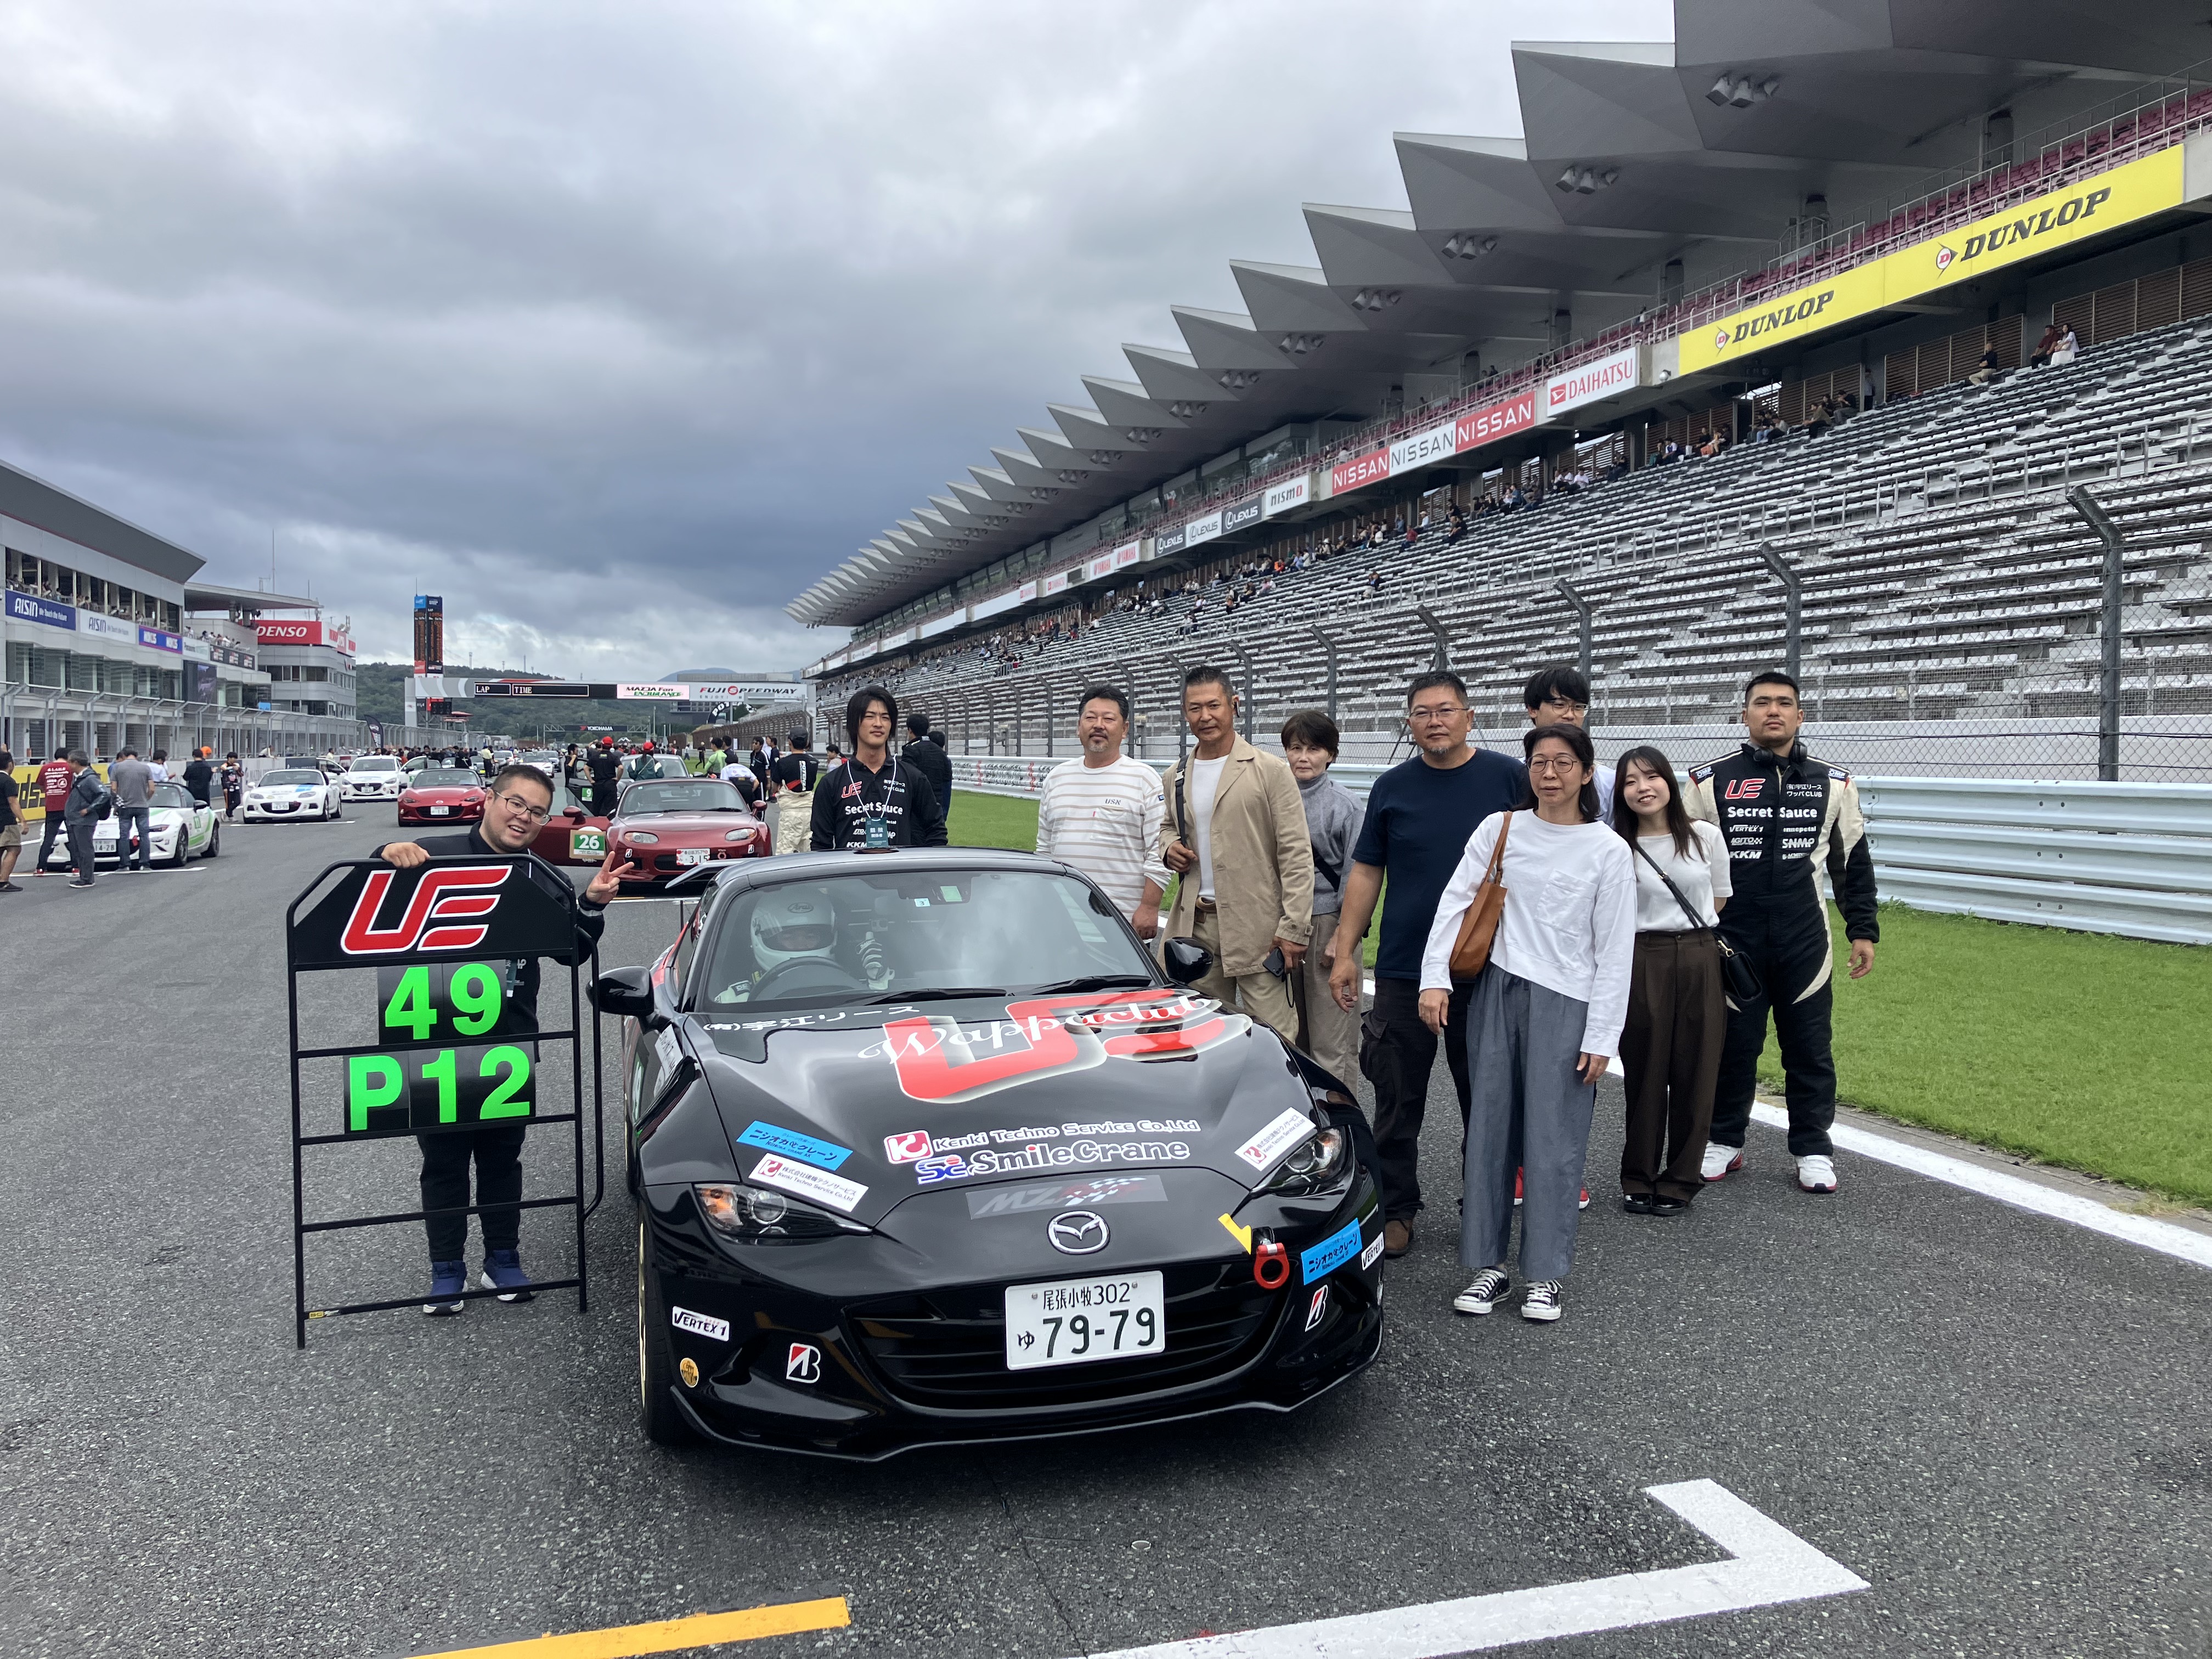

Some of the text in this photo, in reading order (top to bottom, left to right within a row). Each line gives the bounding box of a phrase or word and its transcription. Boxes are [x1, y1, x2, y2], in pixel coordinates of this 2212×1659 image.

[1960, 187, 2111, 263] DUNLOP
[1732, 290, 1834, 344] DUNLOP
[1569, 358, 1633, 399] DAIHATSU
[1458, 400, 1532, 444] NISSAN
[1391, 430, 1454, 468] NISSAN
[1334, 454, 1388, 488] NISSAN
[1234, 505, 1259, 523] LEXUS
[1197, 521, 1218, 535] LEXUS
[1164, 534, 1183, 549] LEXUS
[15, 597, 38, 618] AISIN
[89, 617, 106, 633] AISIN
[257, 626, 307, 637] DENSO
[1829, 769, 1846, 778] OMP
[876, 802, 903, 815] Sauce
[1728, 806, 1818, 818] Secret Sauce
[579, 834, 600, 849] 26
[1729, 850, 1762, 859] KKM
[385, 963, 502, 1040] 49
[349, 1045, 530, 1131] P12
[933, 1133, 989, 1152] Kenki
[991, 1125, 1060, 1143] Techno
[1062, 1121, 1135, 1136] Service
[967, 1140, 1191, 1177] SmileCrane
[777, 1171, 793, 1181] Kenki
[794, 1177, 813, 1187] Techno
[814, 1183, 833, 1194] Service
[1043, 1282, 1130, 1311] 尾張小牧302
[675, 1311, 727, 1336] VERTEX 1
[1018, 1307, 1155, 1358] ゆ 79-79
